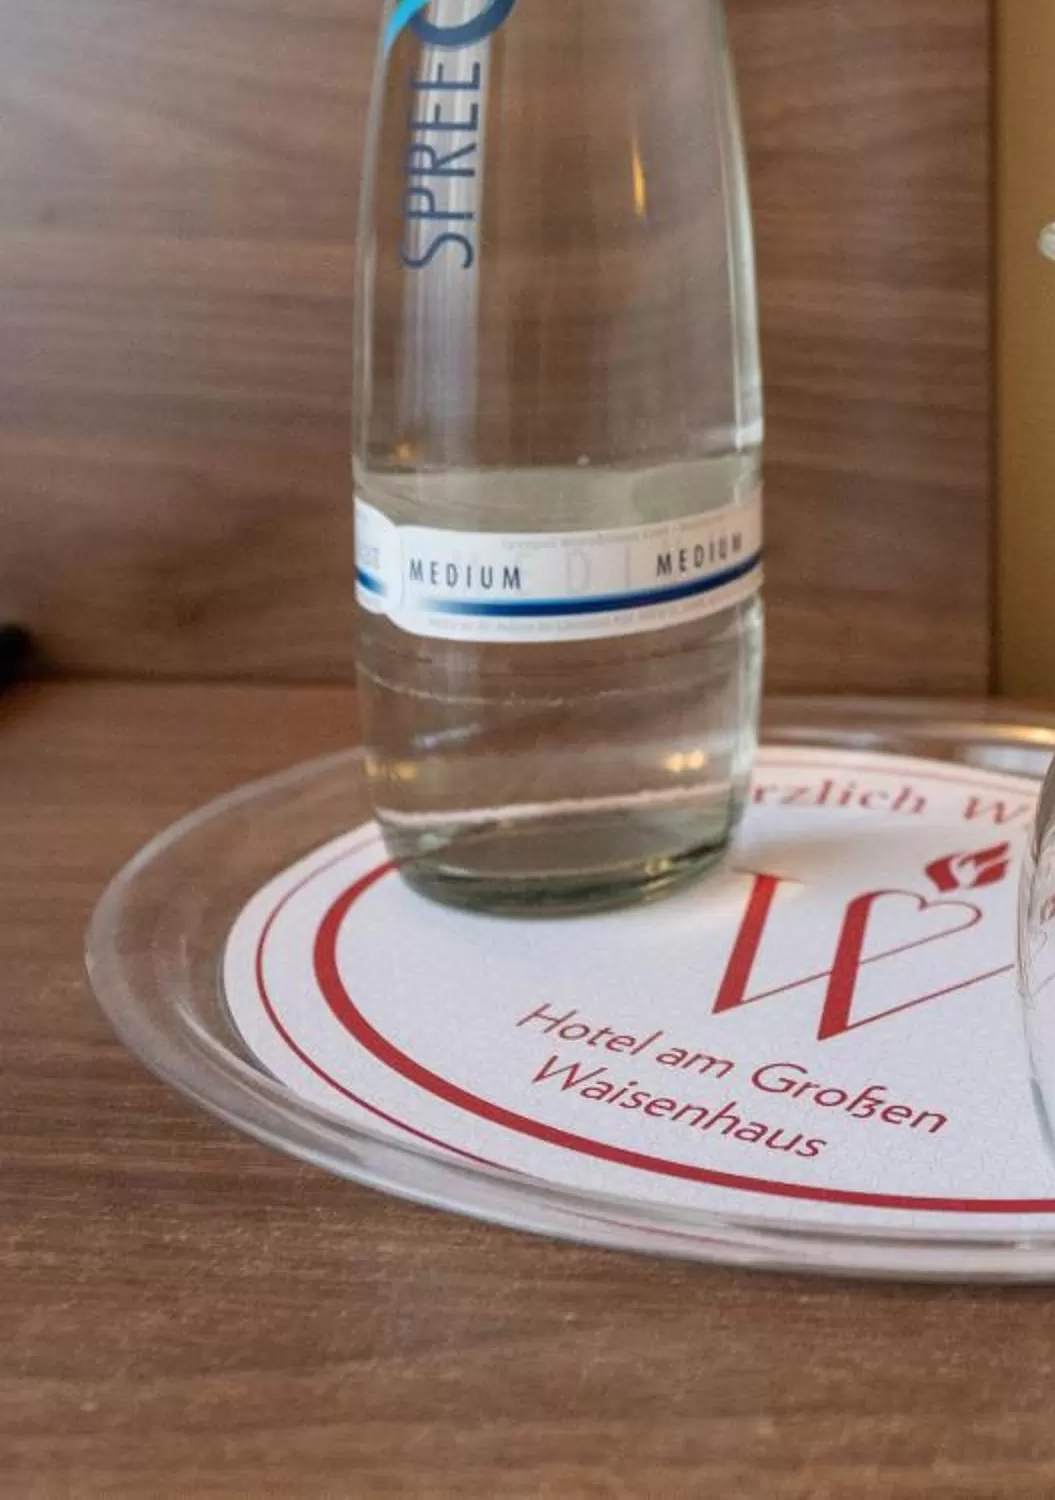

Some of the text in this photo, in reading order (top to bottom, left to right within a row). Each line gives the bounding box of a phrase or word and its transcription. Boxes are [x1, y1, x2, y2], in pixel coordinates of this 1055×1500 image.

[409, 557, 522, 591] MEDIUM
[655, 531, 743, 577] MEDIUM
[752, 778, 926, 815] rzlich
[516, 1002, 949, 1135] Hotel am Großen
[532, 1054, 828, 1159] Waisenhaus
